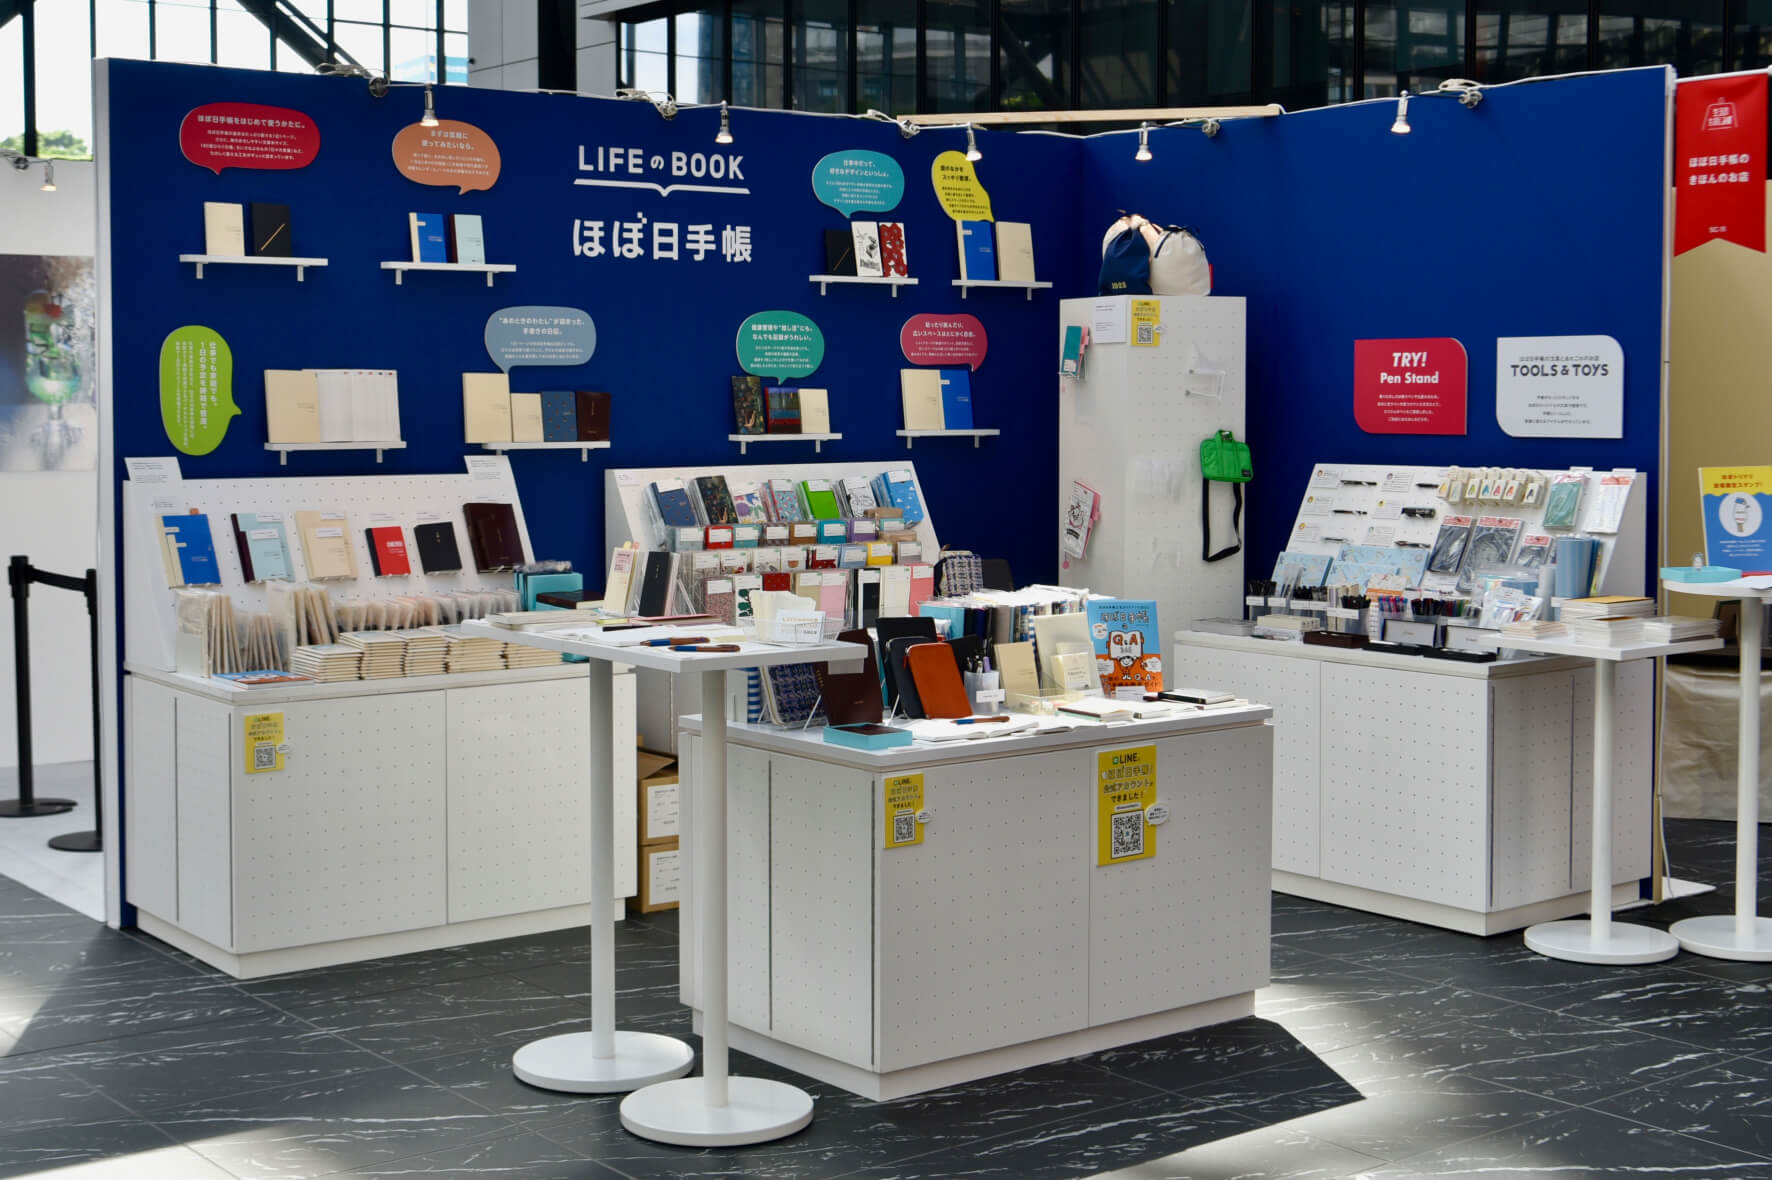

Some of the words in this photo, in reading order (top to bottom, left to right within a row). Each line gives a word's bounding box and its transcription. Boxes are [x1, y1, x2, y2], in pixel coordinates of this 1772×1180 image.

[578, 144, 644, 174] LIFE
[650, 155, 665, 170] の
[671, 151, 745, 180] BOOK
[1688, 153, 1750, 168] ほぼ日手帳の
[1688, 171, 1750, 186] きほんのお店
[572, 211, 752, 263] ほぼ日手帳
[1392, 351, 1428, 368] TRY!
[1379, 371, 1401, 384] Pen
[1404, 370, 1440, 384] Stand
[1510, 364, 1559, 377] TOOLS
[1560, 365, 1570, 376] &
[1571, 363, 1609, 377] TOYS
[1119, 752, 1138, 765] LINE
